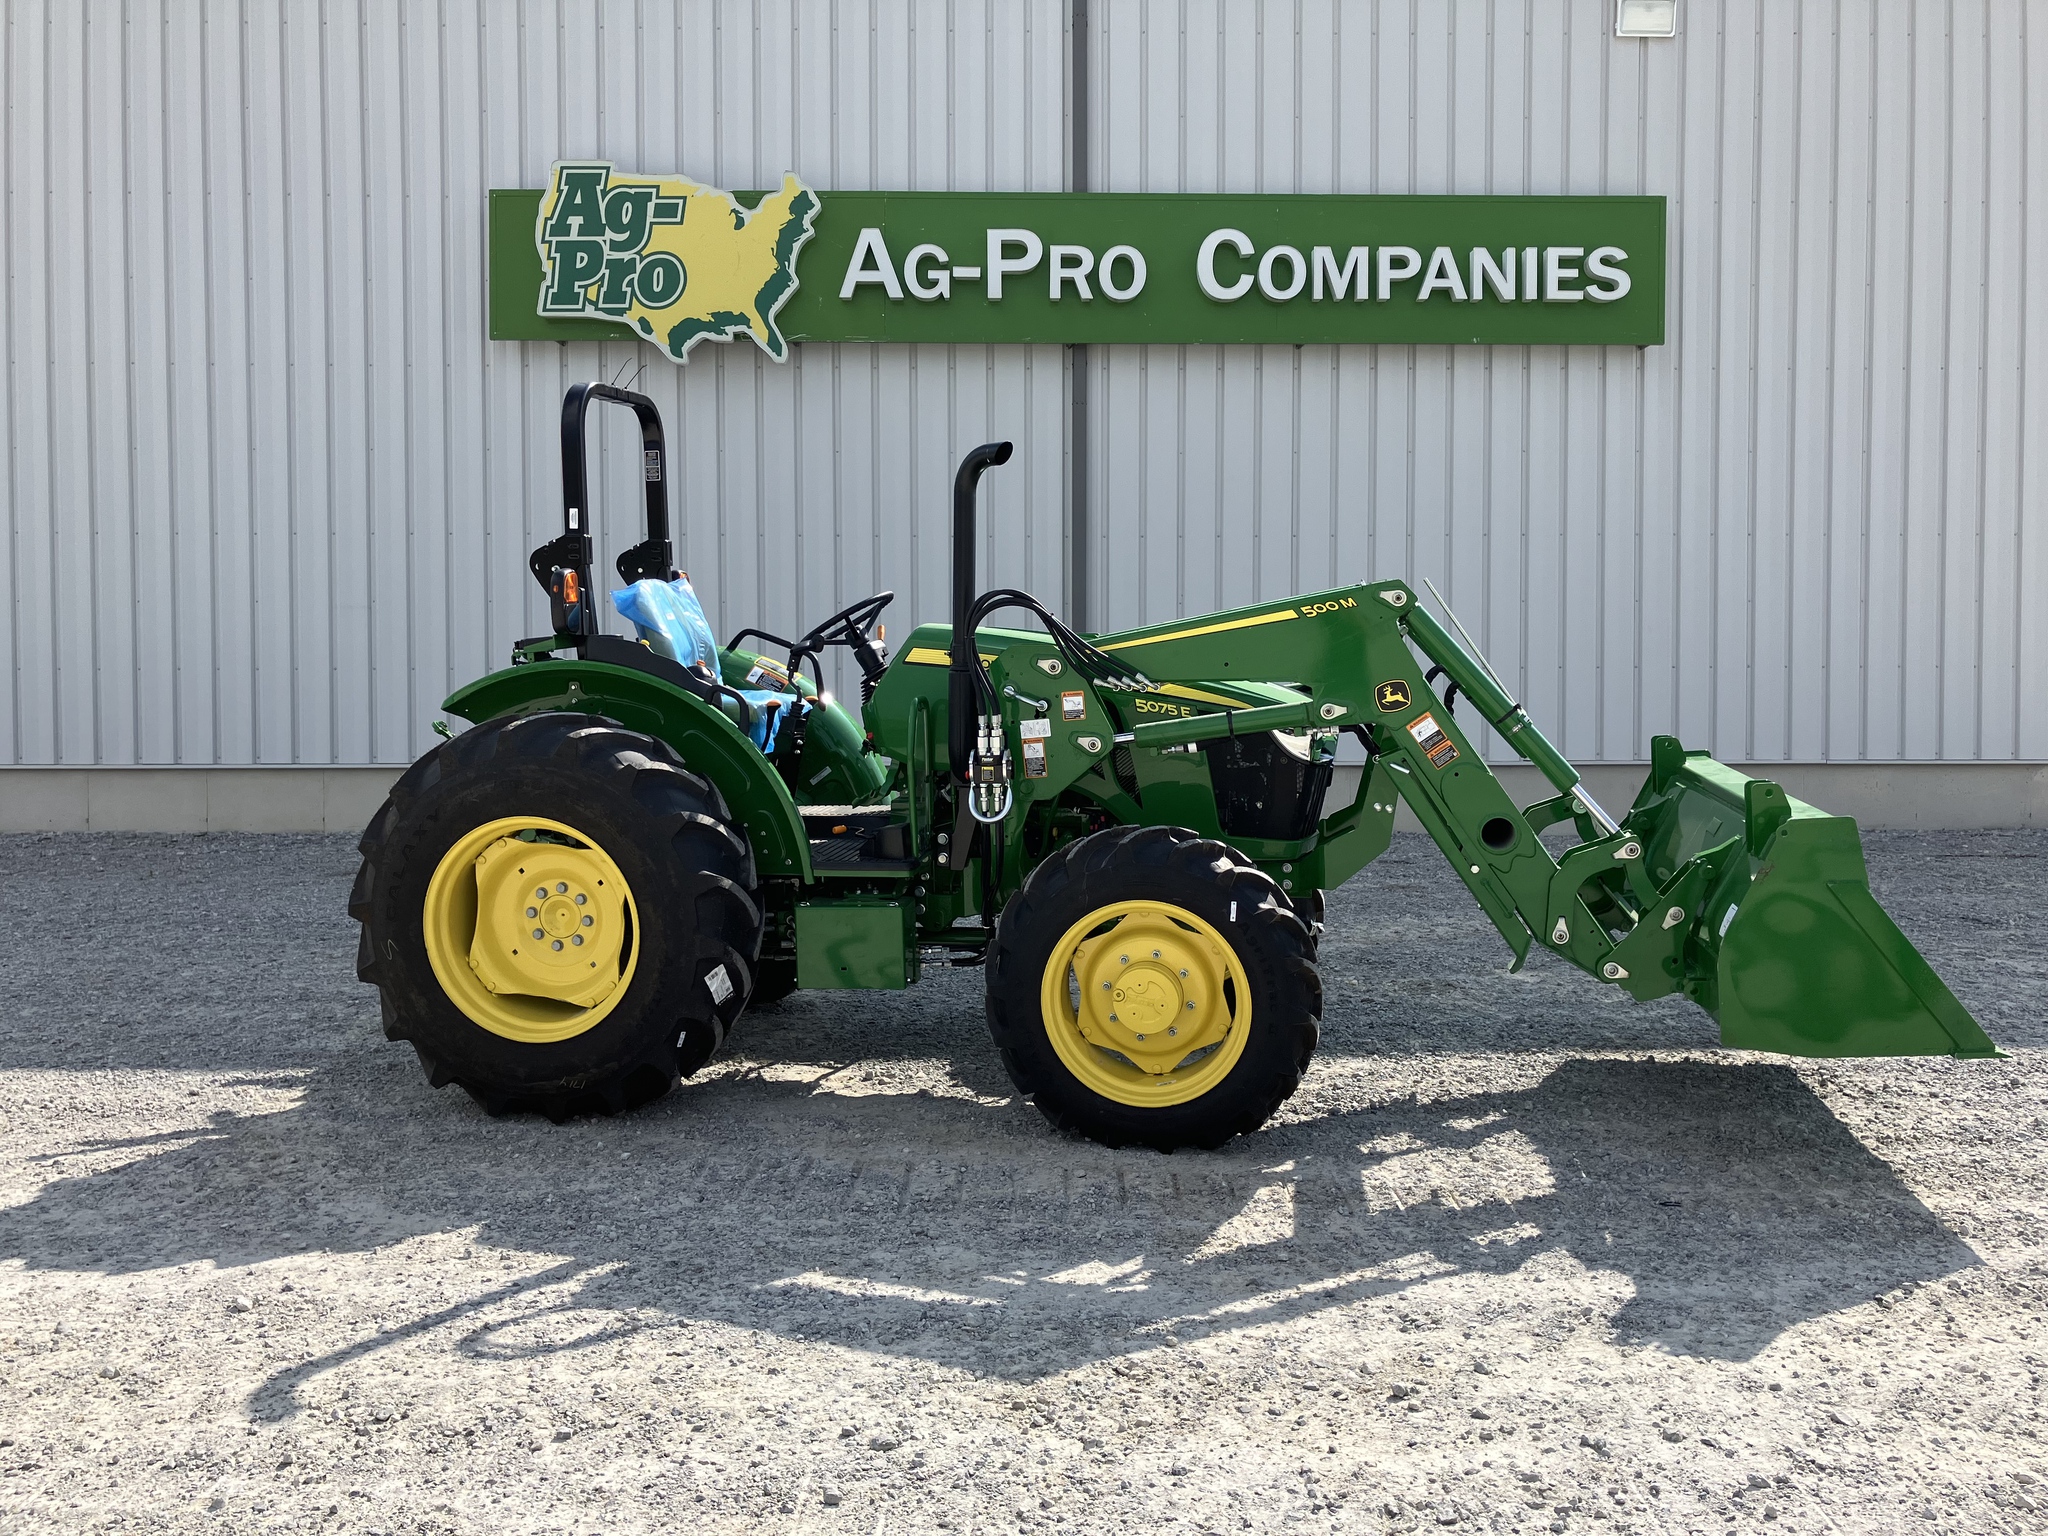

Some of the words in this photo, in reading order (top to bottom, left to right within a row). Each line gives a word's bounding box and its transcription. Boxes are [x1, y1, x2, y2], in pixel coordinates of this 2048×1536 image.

[542, 166, 687, 253] Ag-
[542, 241, 687, 311] Pro
[1300, 601, 1339, 618] 500
[1339, 597, 1358, 608] M
[1135, 698, 1178, 716] 5075
[1180, 706, 1192, 718] E
